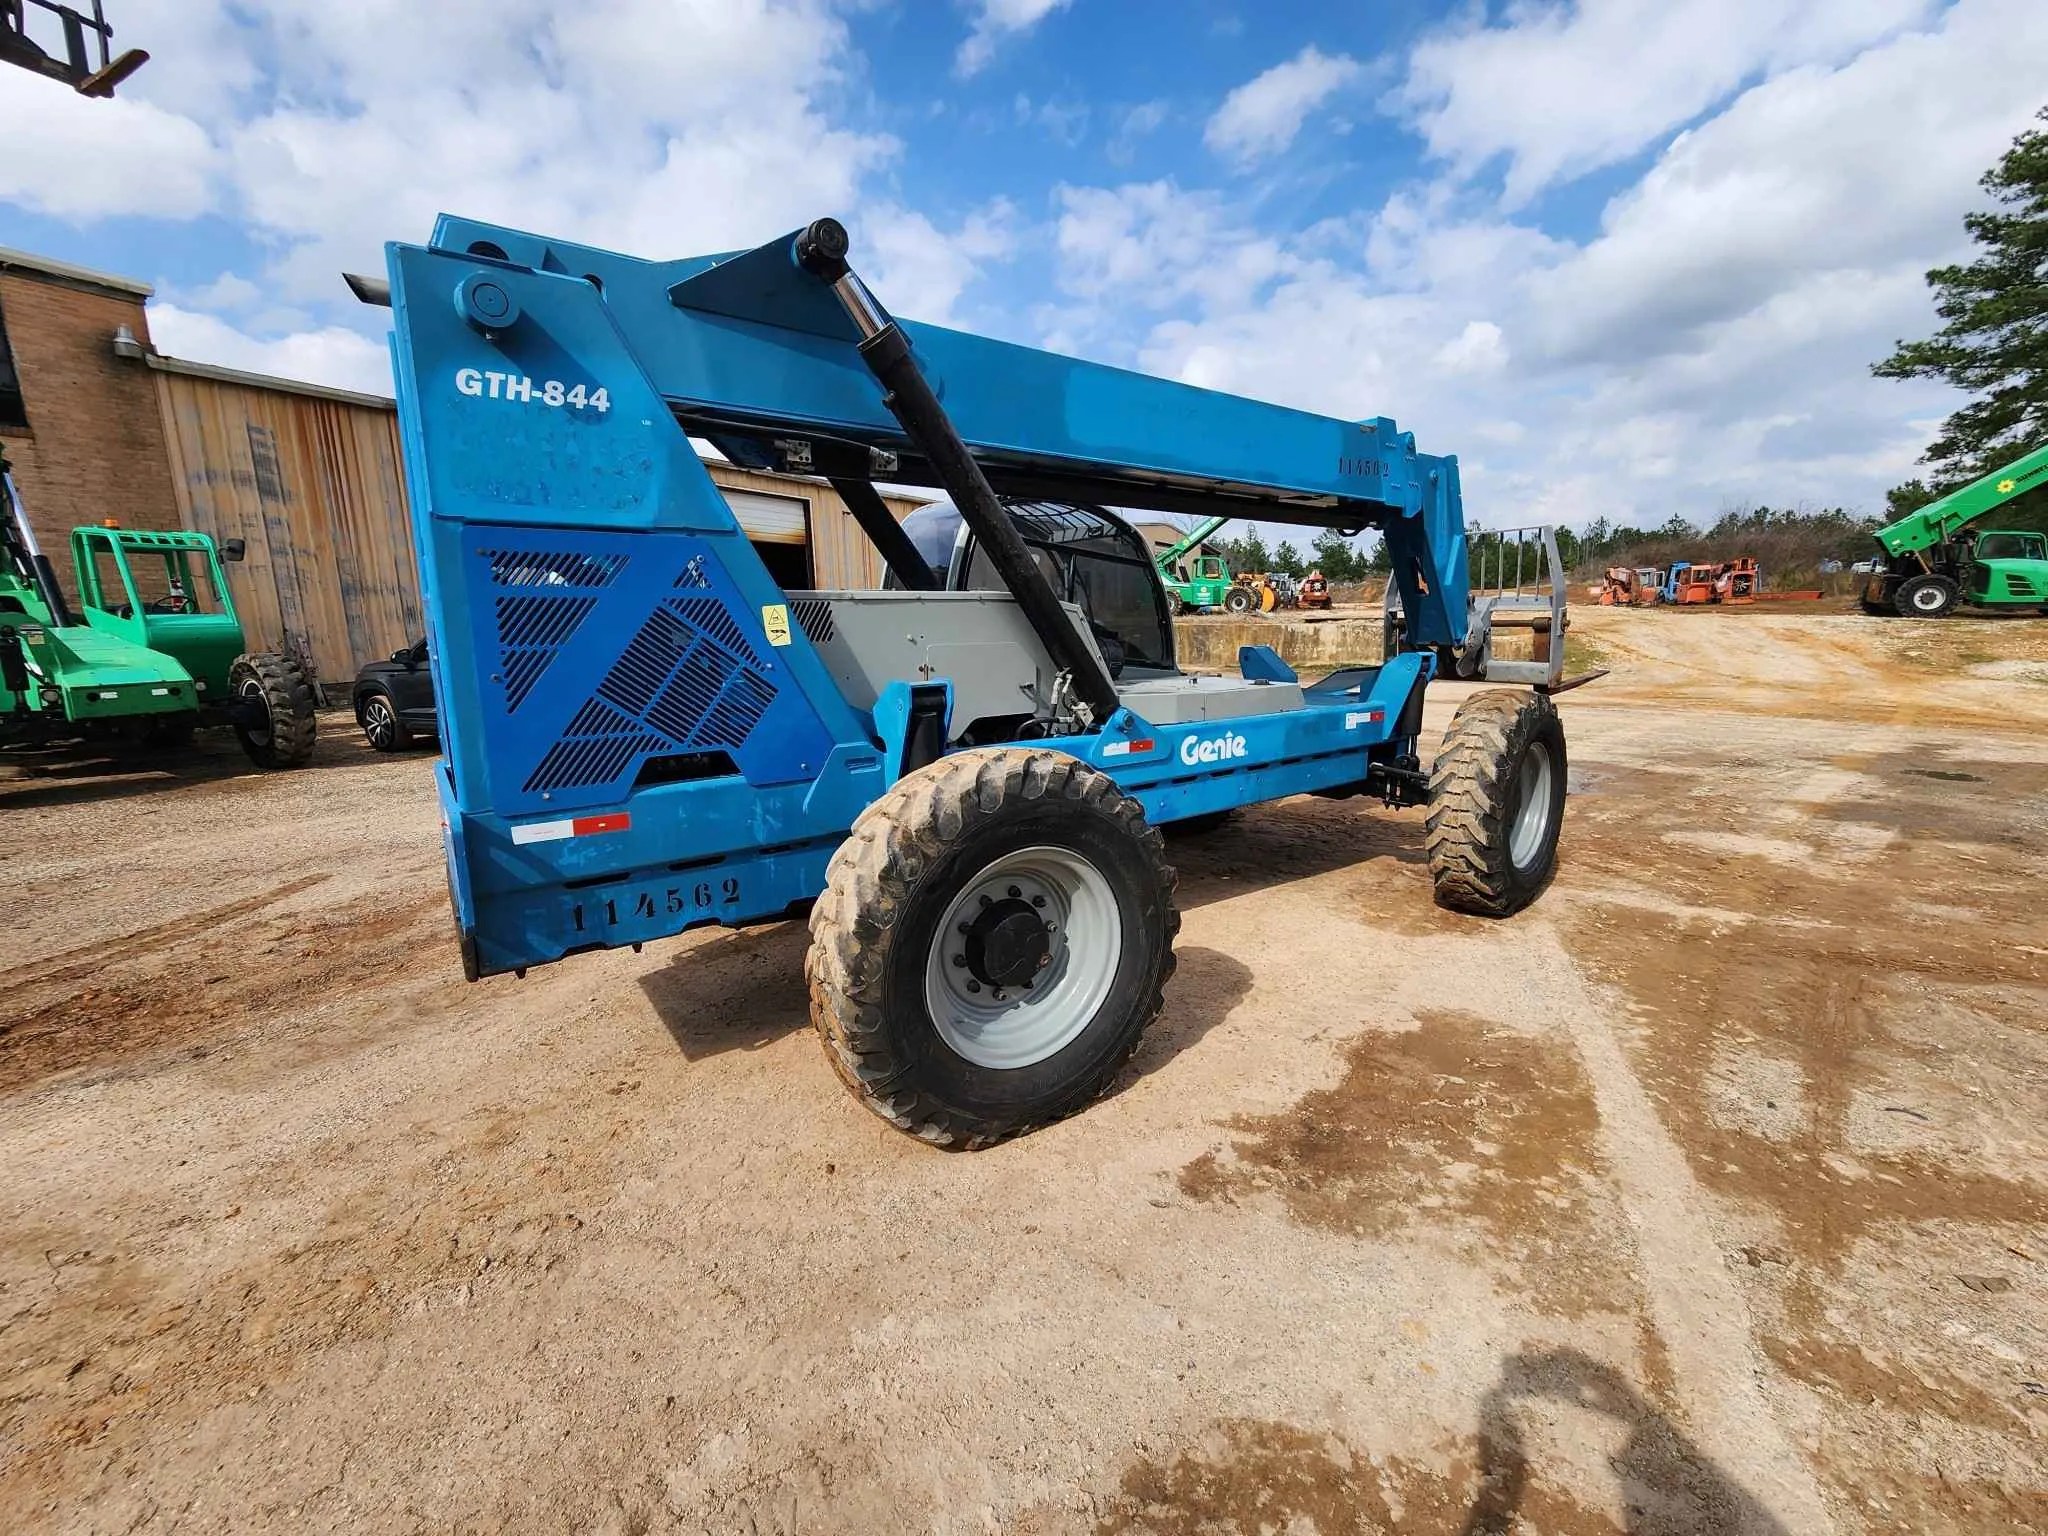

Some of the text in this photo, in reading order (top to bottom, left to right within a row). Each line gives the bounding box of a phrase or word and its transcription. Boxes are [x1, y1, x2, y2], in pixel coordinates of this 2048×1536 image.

[455, 368, 611, 413] GTH-844
[1180, 730, 1247, 766] Genie
[573, 877, 740, 932] 114562
